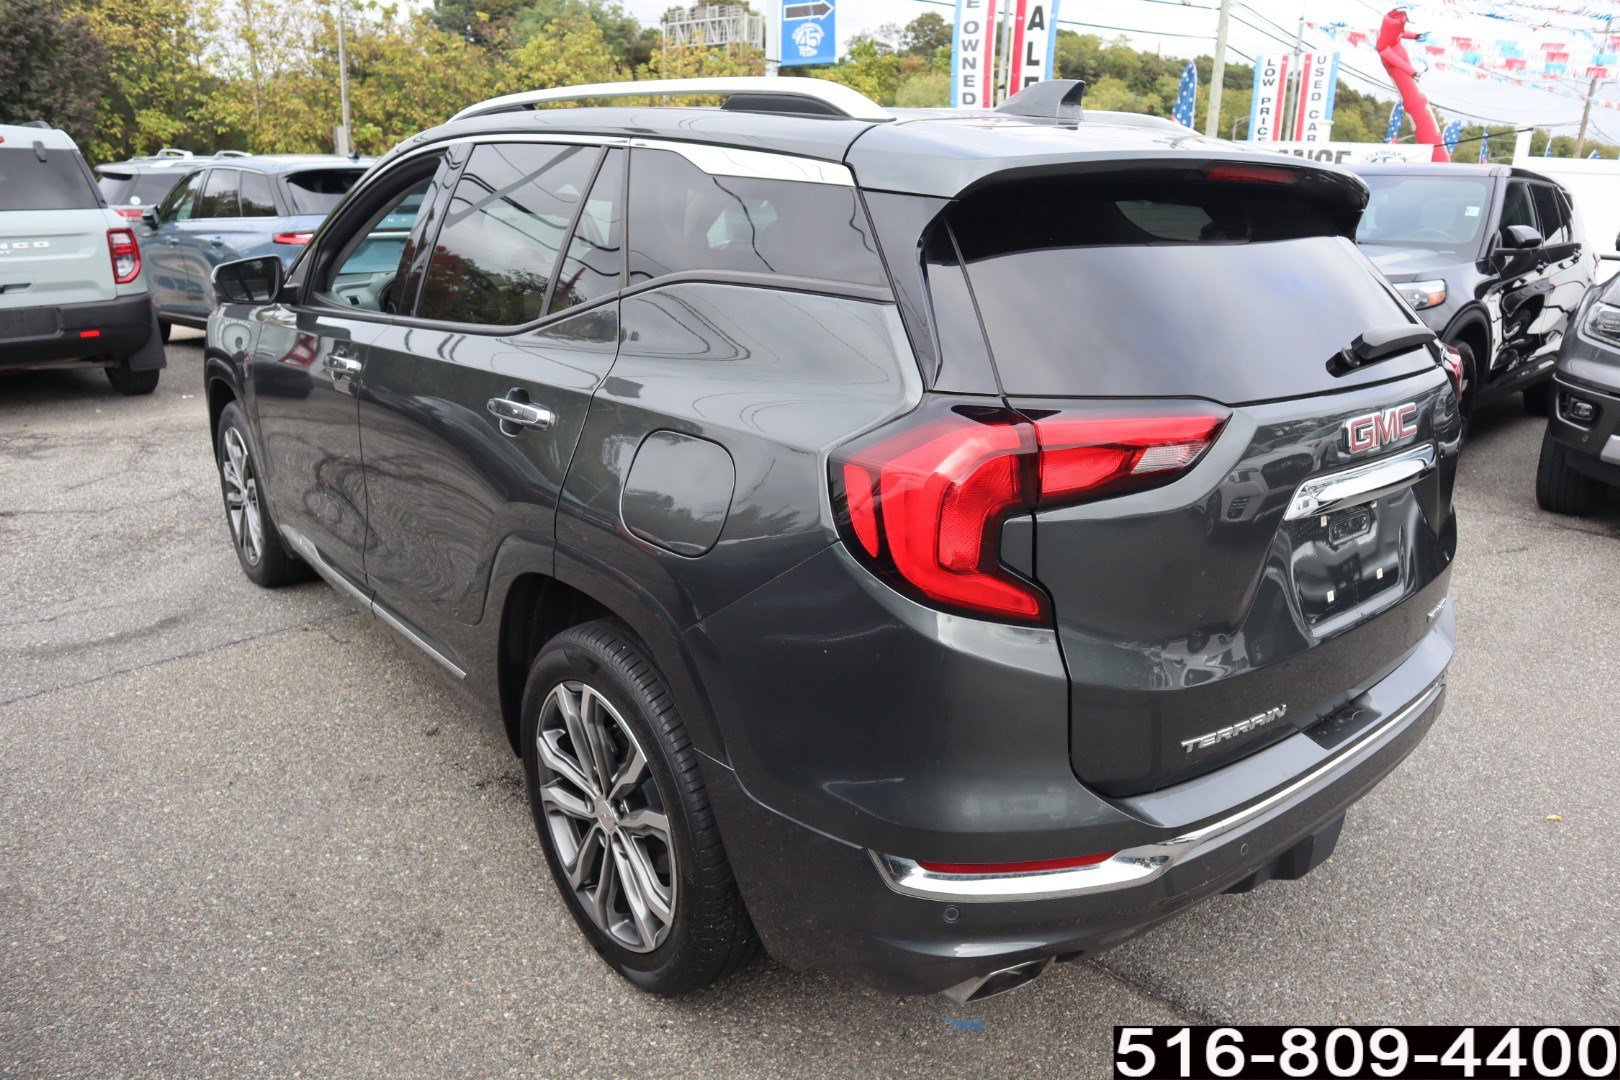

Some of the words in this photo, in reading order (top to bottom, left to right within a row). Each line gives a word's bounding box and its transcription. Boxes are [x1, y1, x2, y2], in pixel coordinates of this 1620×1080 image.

[962, 20, 980, 105] OWNED
[1262, 58, 1276, 87] LOW
[1311, 55, 1326, 101] USED
[1345, 402, 1417, 453] GMC
[1180, 703, 1288, 753] TERRAIN
